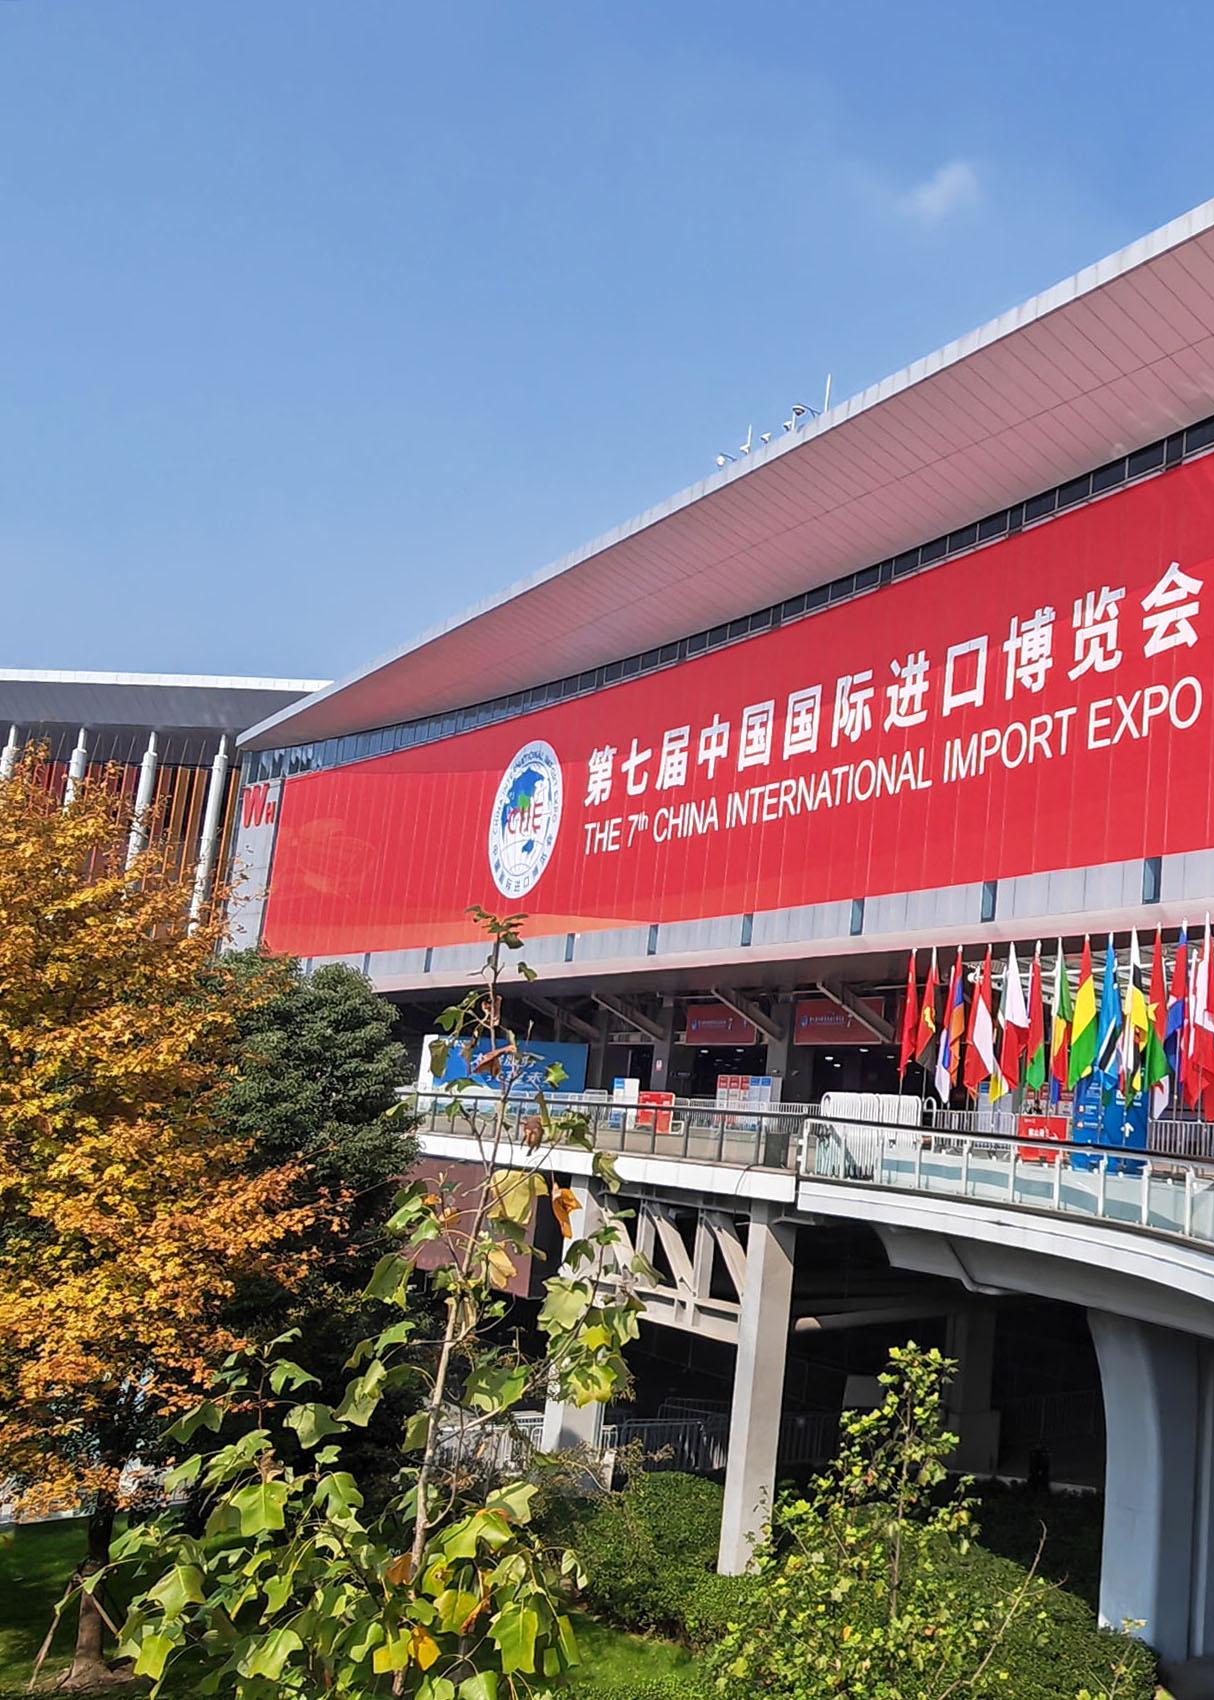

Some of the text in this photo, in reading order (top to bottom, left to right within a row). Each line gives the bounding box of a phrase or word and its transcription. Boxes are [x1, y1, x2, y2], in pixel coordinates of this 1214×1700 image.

[583, 675, 1203, 856] THE 7th CHINA INTERNATIONAL IMPORT EXPO
[584, 561, 1204, 808] 第七届中国国际进口博览会
